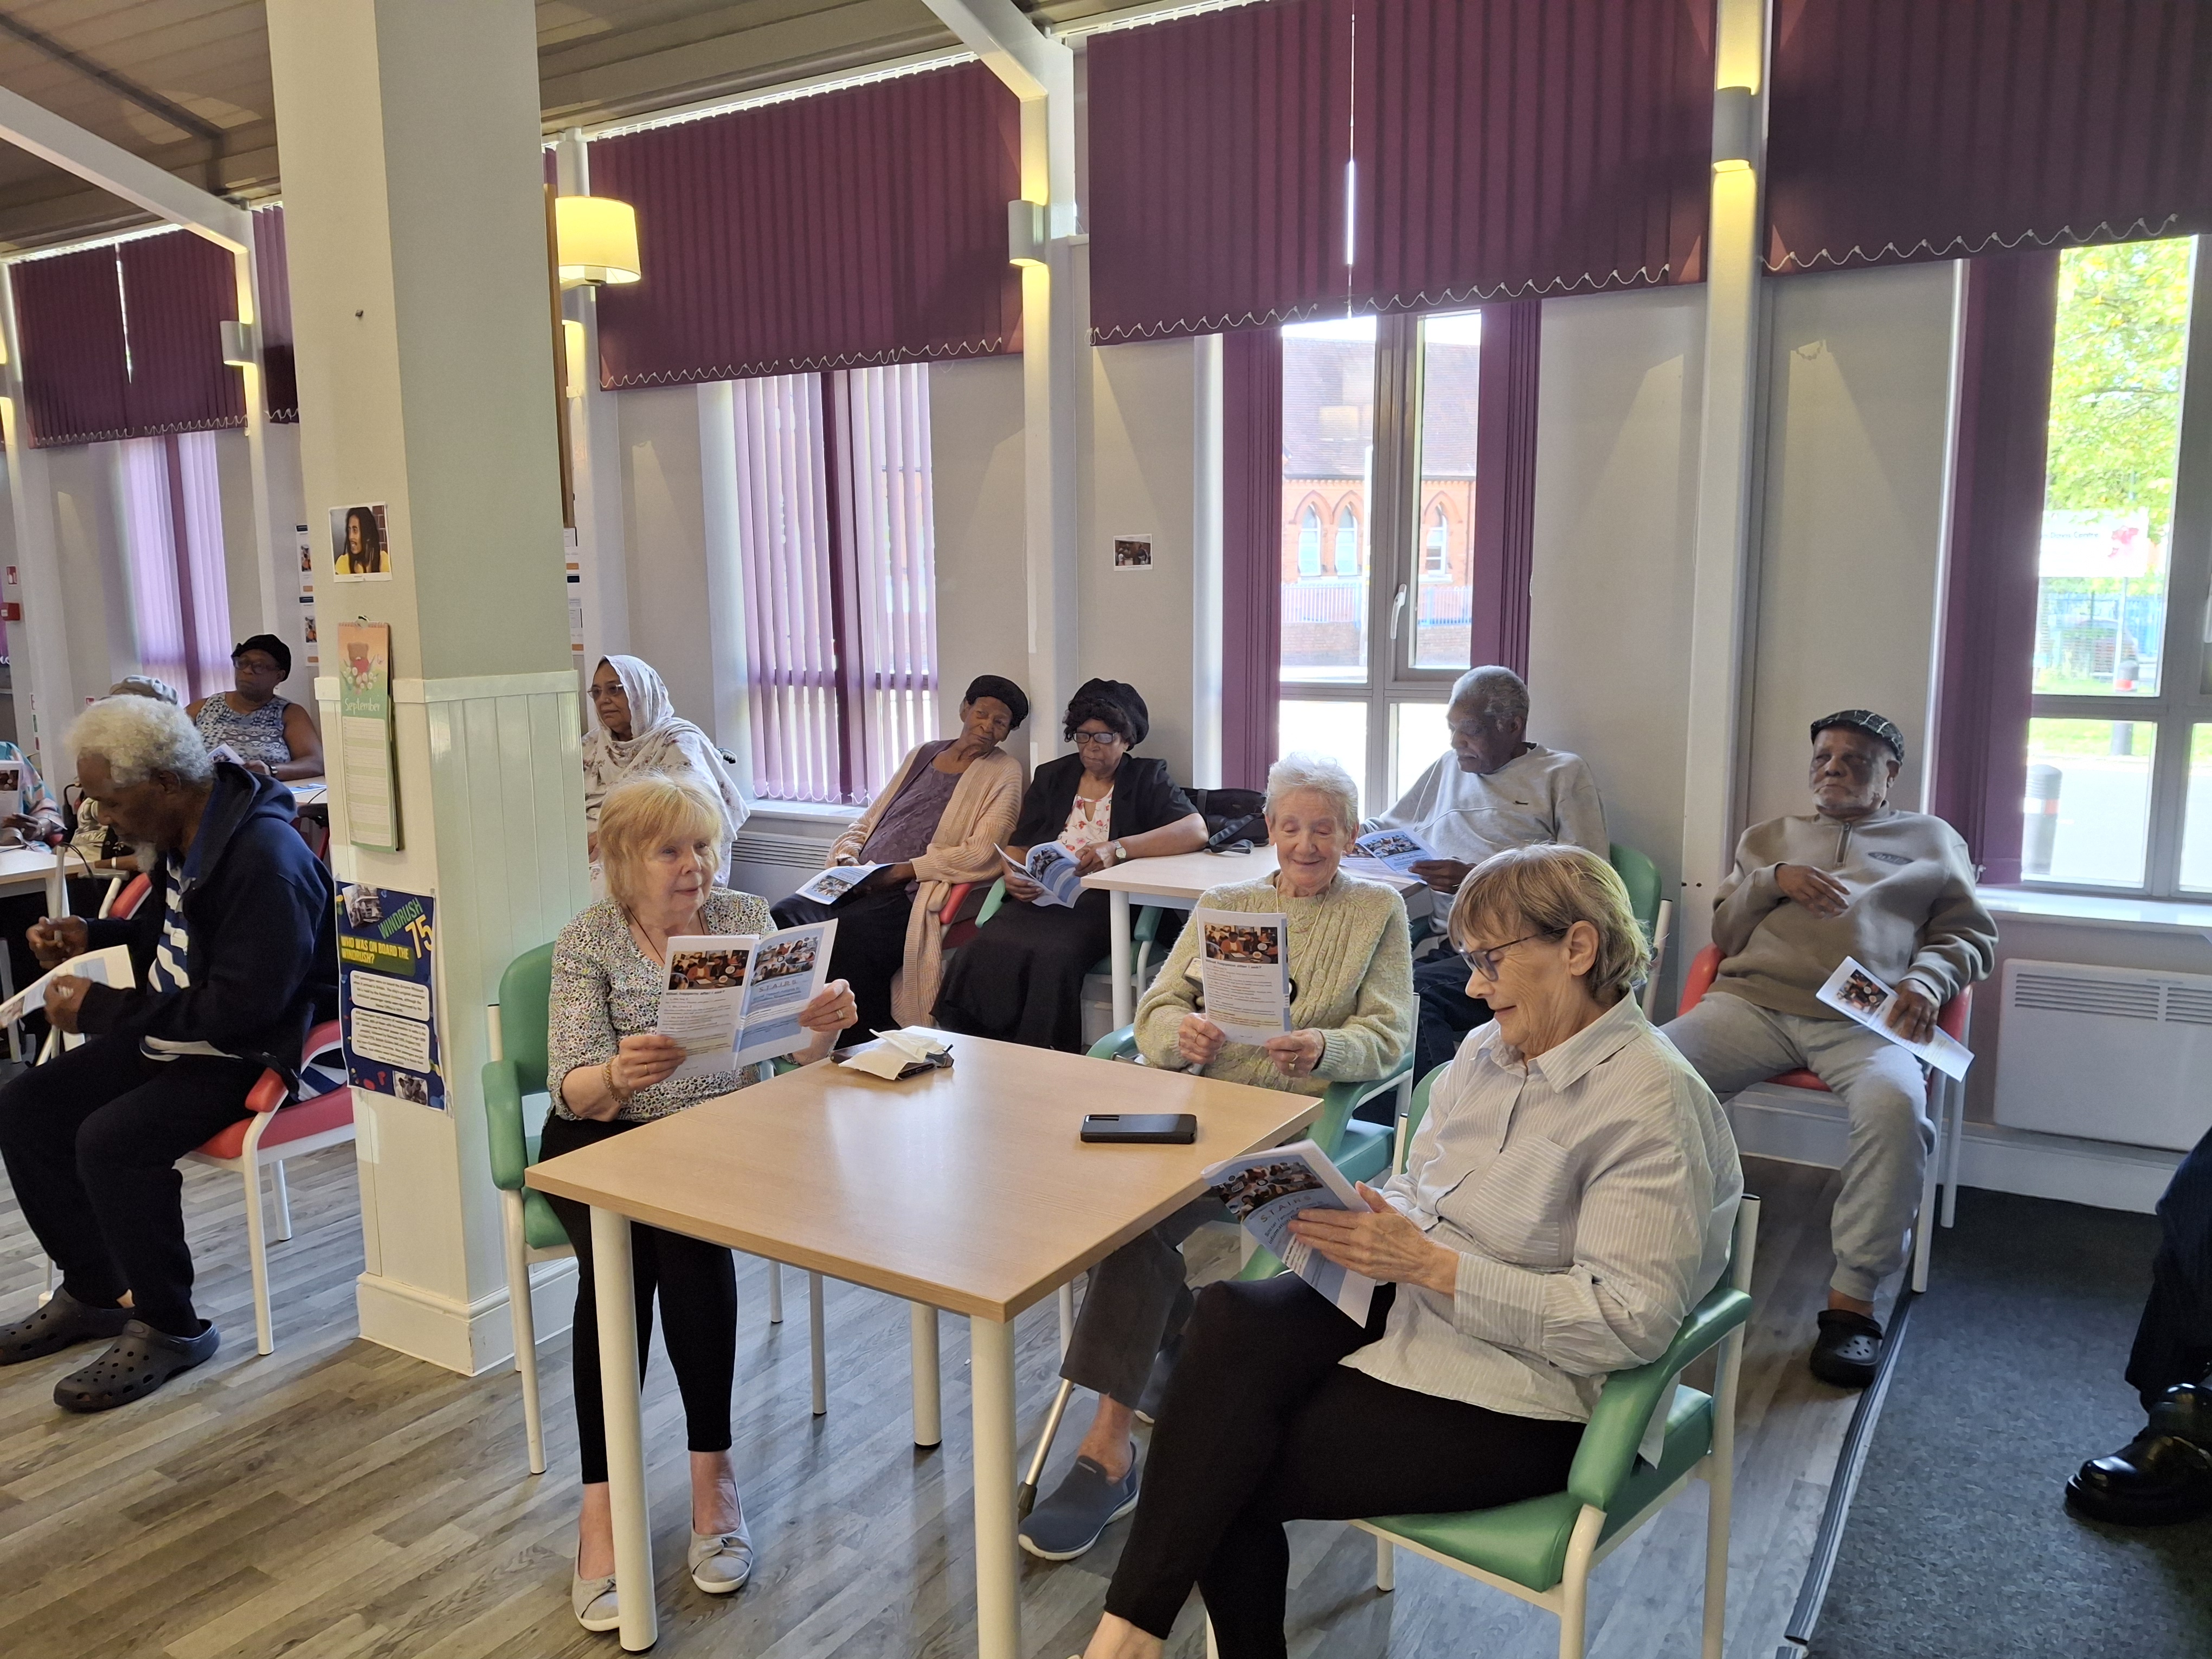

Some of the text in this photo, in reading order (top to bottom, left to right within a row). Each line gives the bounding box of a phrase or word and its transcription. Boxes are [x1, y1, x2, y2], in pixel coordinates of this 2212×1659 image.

[344, 697, 381, 715] September
[377, 897, 423, 940] WINDRUSH
[340, 935, 409, 960] WHO WAS ON BOARD THE
[404, 914, 433, 959] 75
[342, 948, 375, 964] WINDRUSH?
